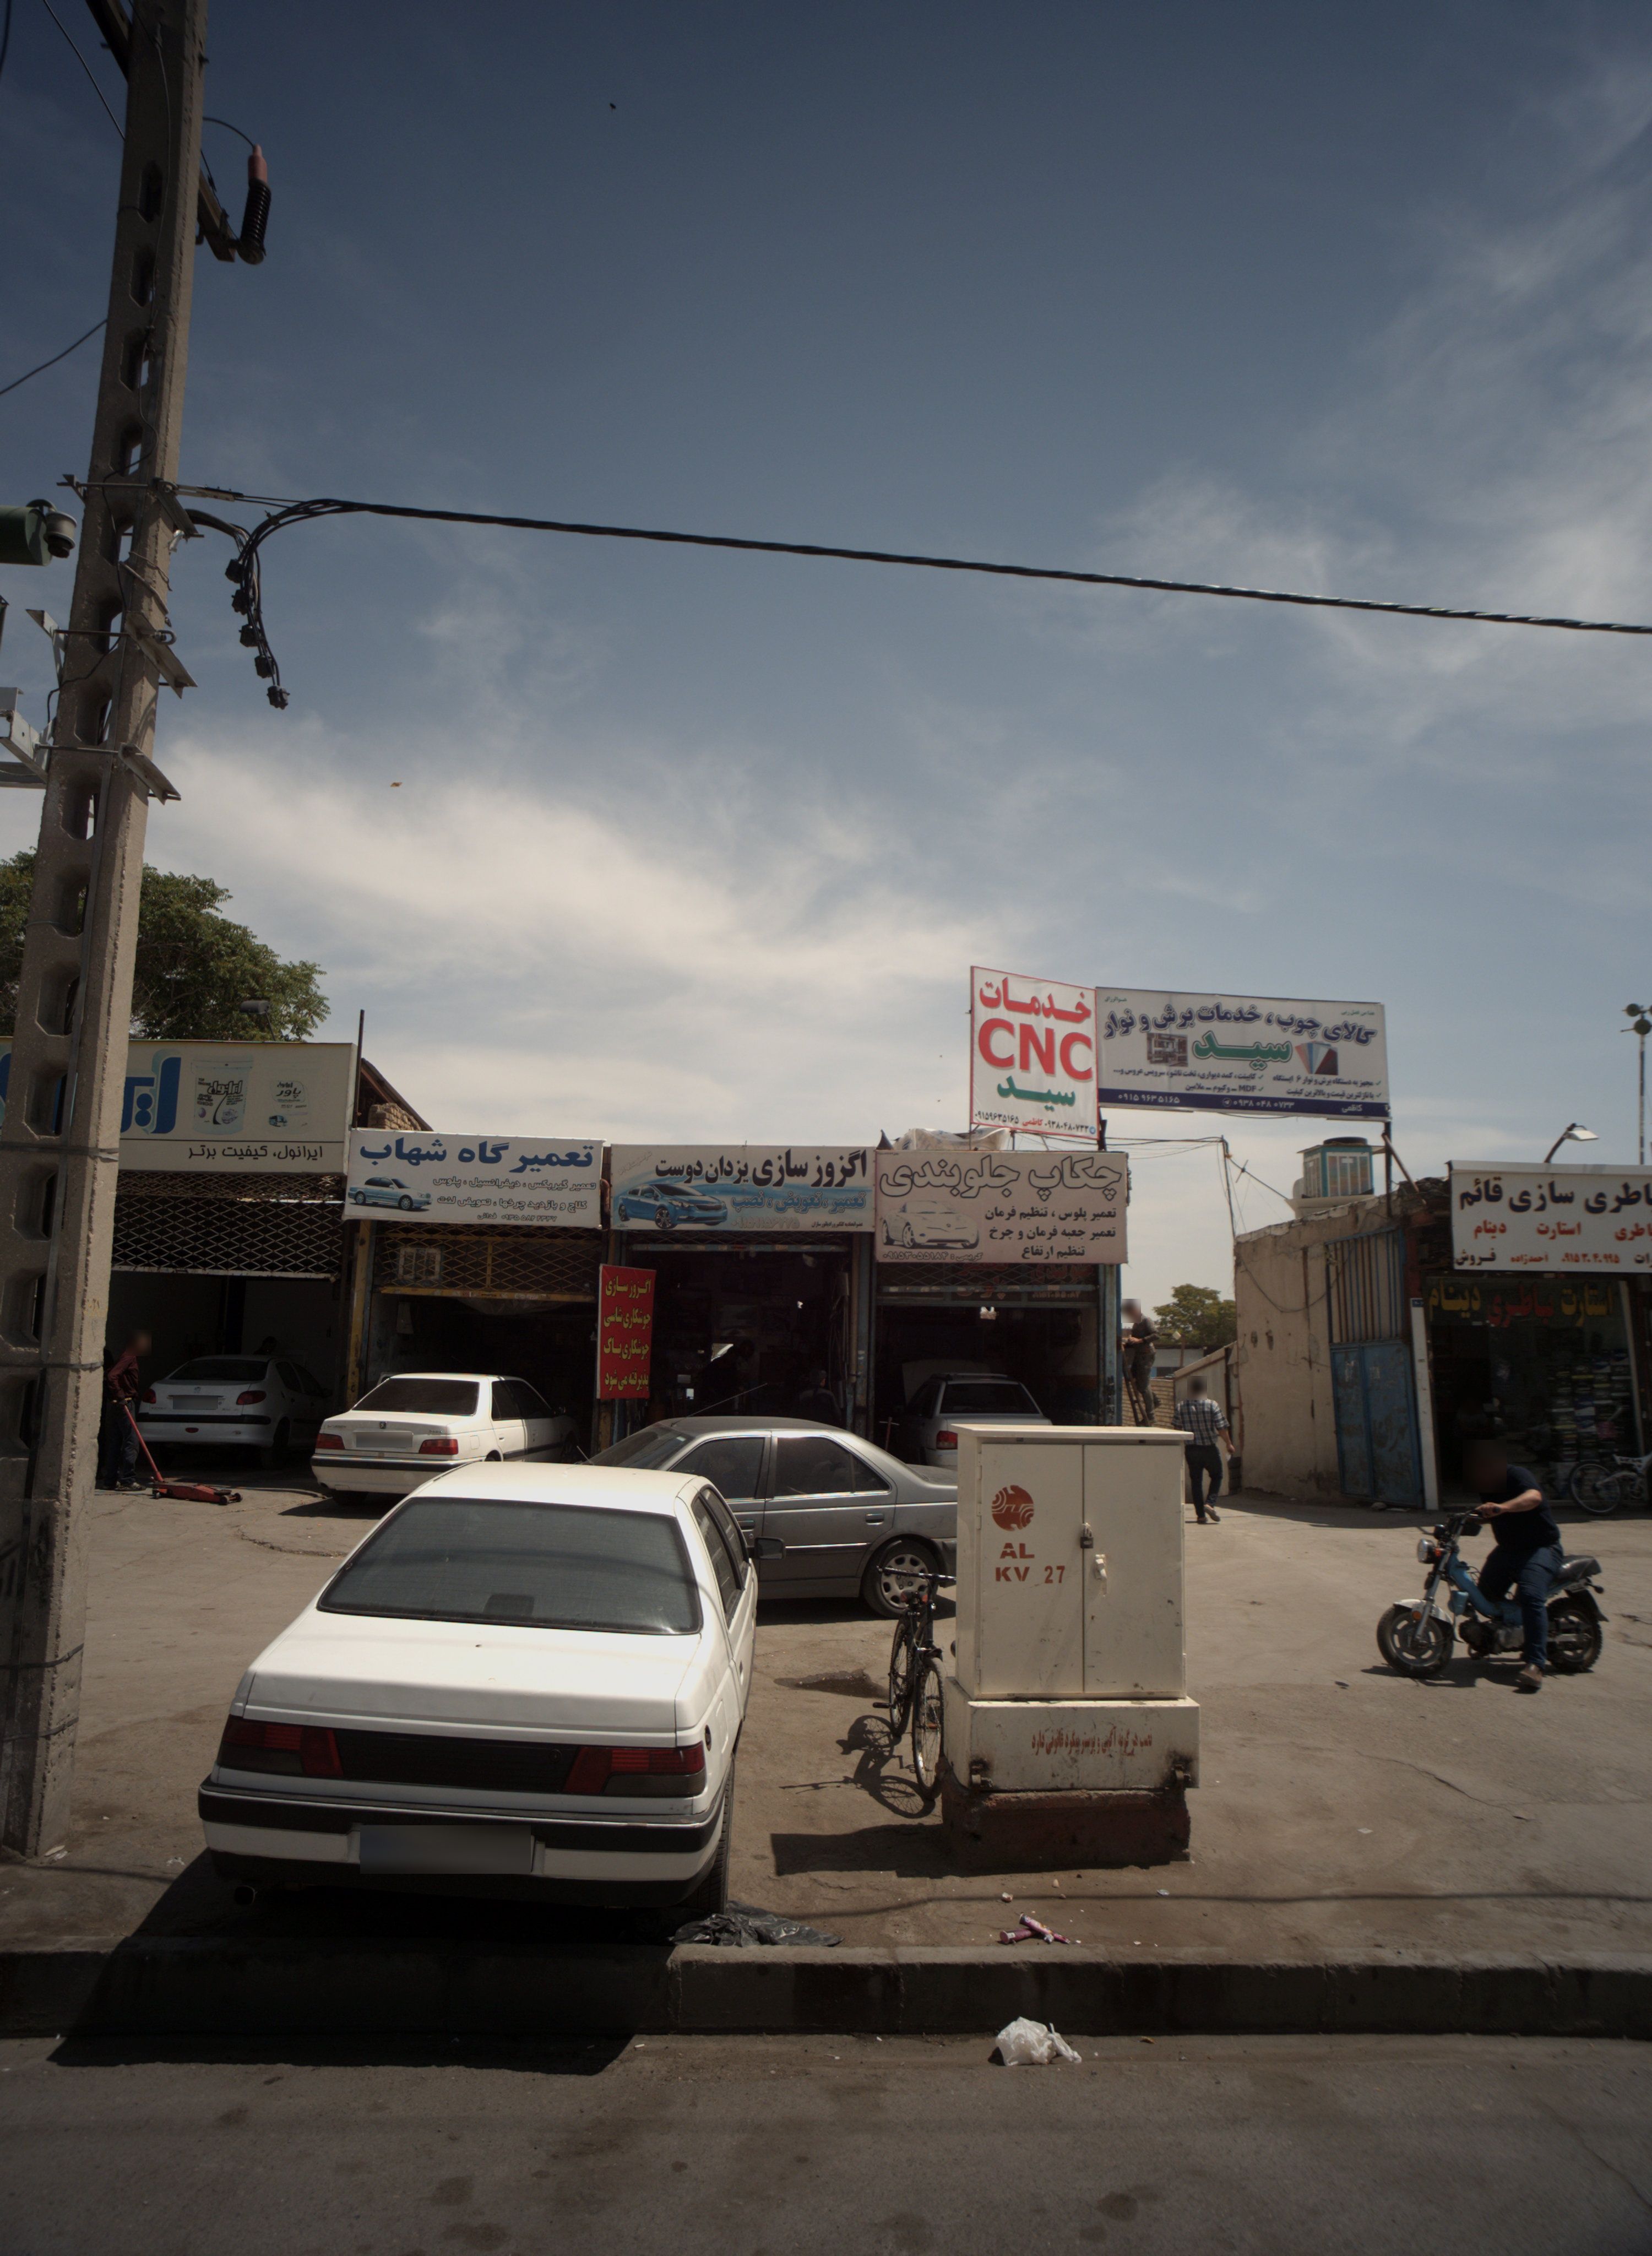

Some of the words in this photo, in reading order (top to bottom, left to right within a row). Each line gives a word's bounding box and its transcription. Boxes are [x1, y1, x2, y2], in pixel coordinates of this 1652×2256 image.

[980, 977, 1091, 1023] خدمات
[1154, 1004, 1195, 1030] برش
[1197, 1002, 1262, 1023] خدمات
[1104, 1008, 1136, 1039] نوار
[1139, 1014, 1151, 1032] و
[1323, 1021, 1377, 1045] کالای
[979, 1018, 1093, 1081] CNC
[1192, 1031, 1292, 1071] سید
[997, 1075, 1075, 1111] سید
[1158, 1095, 1180, 1103] ۵۱۶۵
[189, 1145, 216, 1159] برتر
[222, 1145, 268, 1160] کیفیت
[360, 1137, 447, 1166] شهاب
[752, 1149, 808, 1187] سازی
[811, 1149, 867, 1187] اگزوز
[433, 1176, 461, 1188] پلوس
[569, 1183, 596, 1191] تعمیر
[1028, 1156, 1122, 1201] چکاپ
[437, 1196, 457, 1205] لنت
[458, 1197, 491, 1207] تعویض
[731, 1190, 764, 1212] نصب
[1460, 1176, 1503, 1210] قائم
[1509, 1181, 1574, 1212] سازی
[1585, 1182, 1652, 1214] اطری
[528, 1200, 558, 1210] بازدید
[559, 1202, 566, 1211] و
[568, 1200, 588, 1213] کلاچ
[985, 1206, 1016, 1221] فرمان
[1019, 1206, 1048, 1220] تنظیم
[1090, 1208, 1117, 1221] تعمیر
[989, 1226, 1014, 1240] چرخ
[1018, 1230, 1023, 1240] و
[1026, 1225, 1058, 1240] فرمان
[1061, 1229, 1085, 1239] جعبه
[1089, 1227, 1116, 1240] تعمیر
[1474, 1219, 1507, 1239] دینام
[1536, 1221, 1582, 1240] استارت
[1615, 1223, 1652, 1241] اطری
[1021, 1245, 1053, 1259] ارتفاع
[1057, 1246, 1085, 1259] تنظیم
[1456, 1248, 1496, 1265] فروش
[606, 1276, 628, 1297] سازی
[628, 1278, 651, 1299] اگزوز
[1429, 1278, 1480, 1321] دینام
[1488, 1281, 1554, 1328] باطری
[1561, 1282, 1613, 1327] استارت
[604, 1306, 623, 1328] شاسی
[623, 1308, 651, 1330] جوشکاری
[622, 1338, 650, 1360] جوشکاری
[628, 1369, 649, 1391] پذیرفته
[999, 1542, 1035, 1559] AL
[995, 1566, 1031, 1582] KV
[1044, 1565, 1066, 1584] 27
